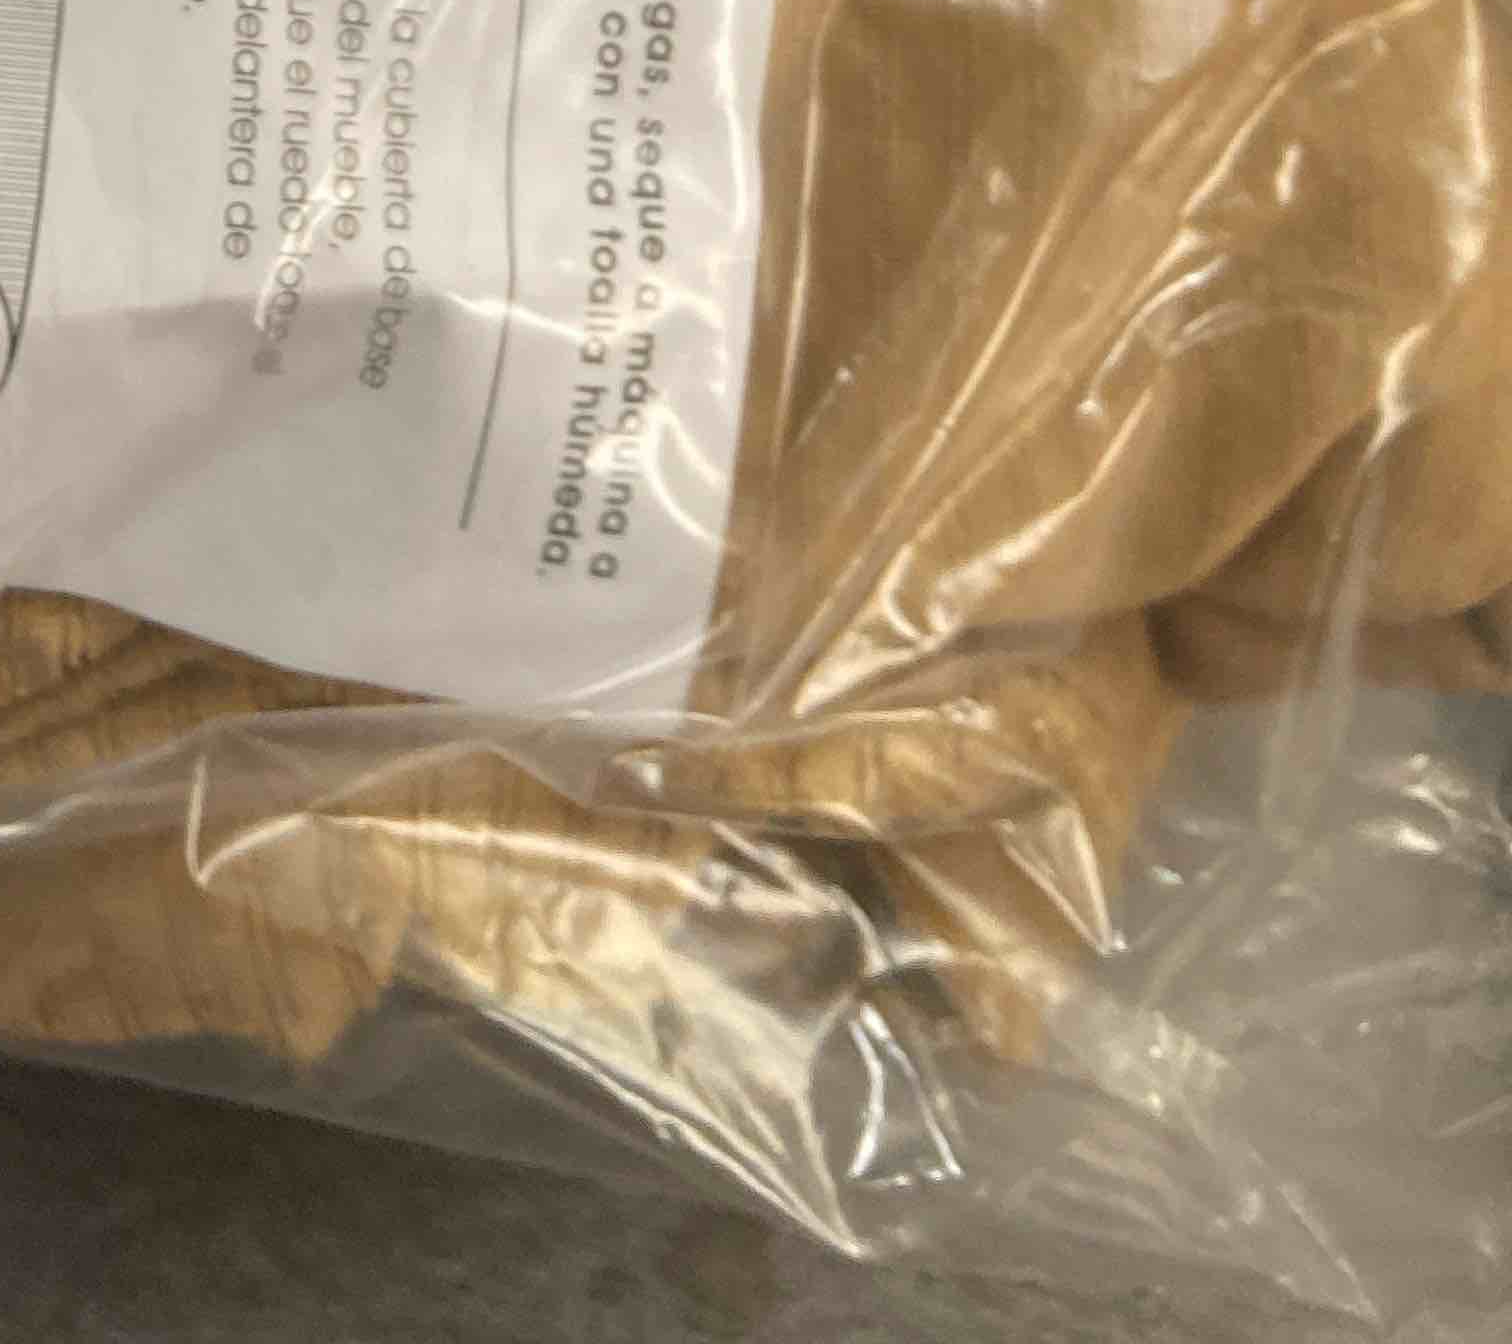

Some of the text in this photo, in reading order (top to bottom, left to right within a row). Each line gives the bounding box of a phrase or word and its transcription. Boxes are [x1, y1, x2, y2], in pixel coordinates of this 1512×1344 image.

[337, 0, 374, 62] del
[391, 10, 424, 43] la
[593, 11, 626, 98] con
[284, 59, 315, 94] el
[277, 109, 315, 232] ruedo
[327, 77, 364, 250] mueble,
[383, 58, 421, 230] cubierta
[586, 117, 618, 207] una
[223, 201, 260, 259] de
[630, 117, 669, 263] seque
[383, 245, 418, 299] de
[580, 230, 623, 365] toalla
[358, 306, 407, 389] base
[537, 385, 608, 577] húmeda.
[588, 552, 618, 580] a
